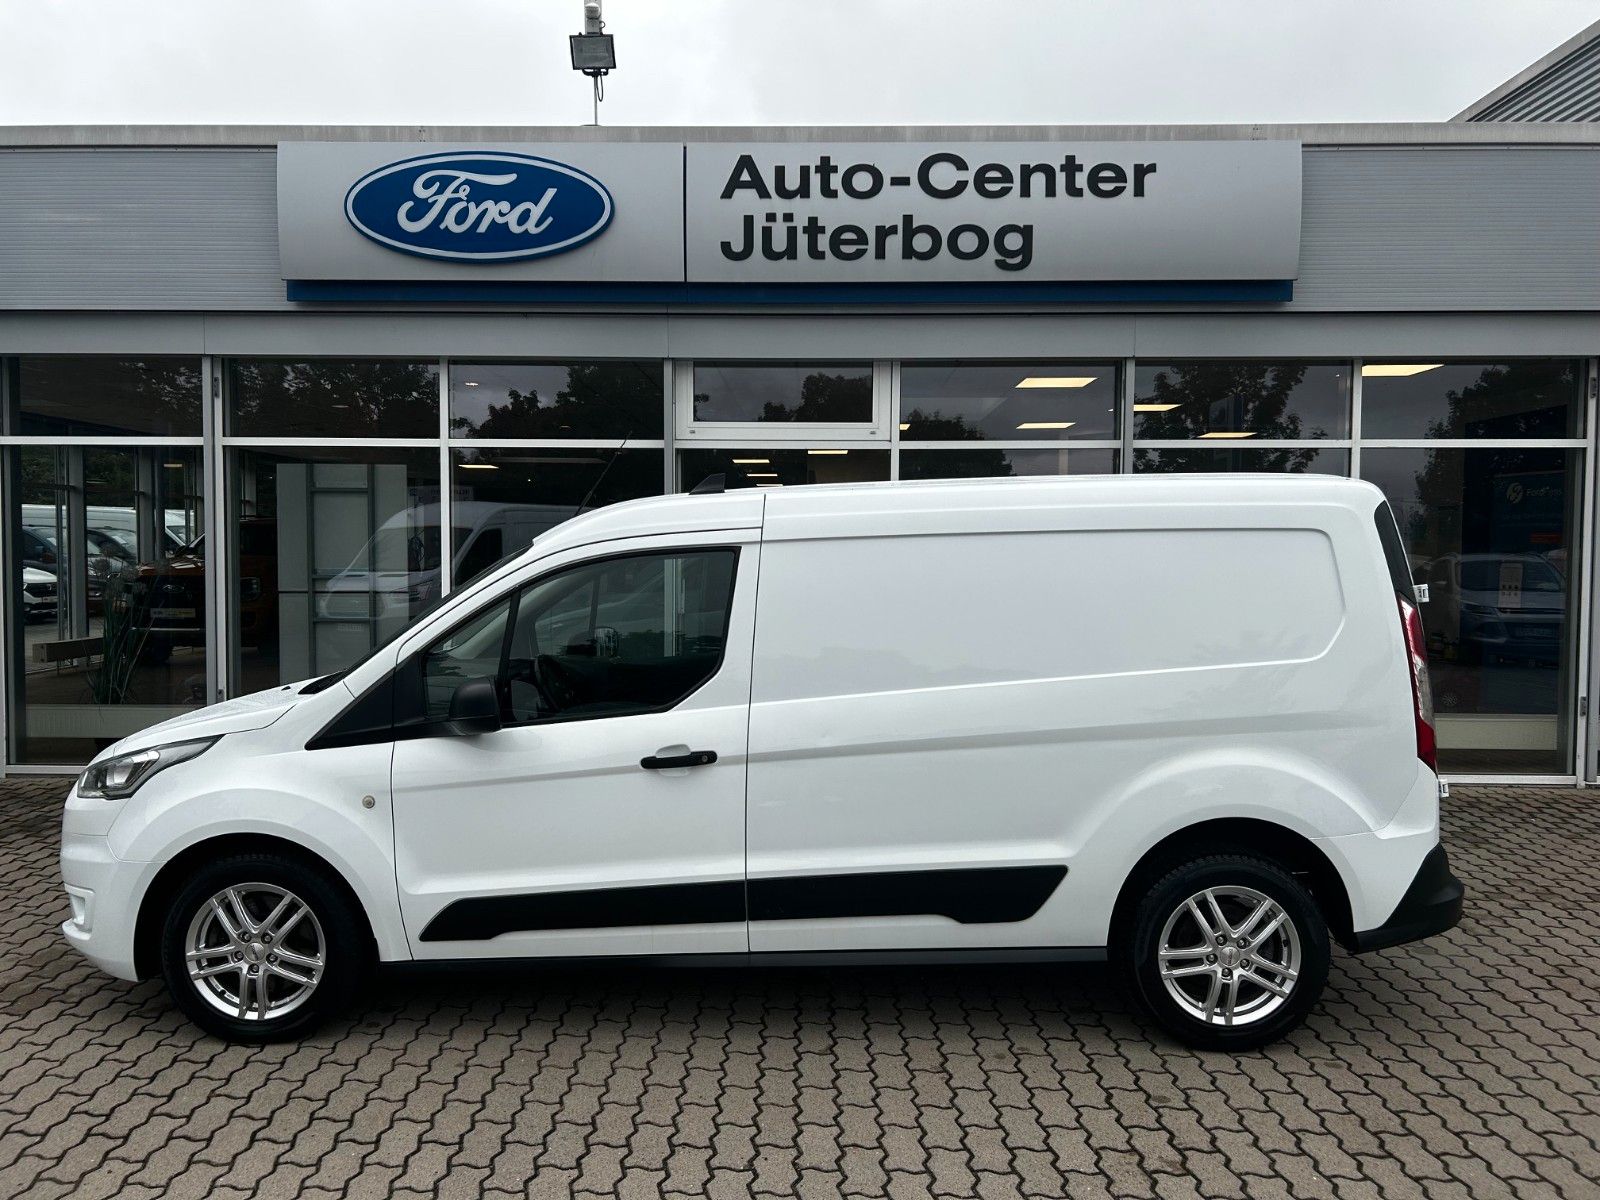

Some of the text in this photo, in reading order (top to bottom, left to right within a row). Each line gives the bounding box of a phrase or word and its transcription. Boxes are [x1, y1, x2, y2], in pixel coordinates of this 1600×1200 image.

[397, 169, 558, 235] Ford
[720, 153, 1157, 199] Auto-Center
[720, 213, 1034, 272] Jüterbog
